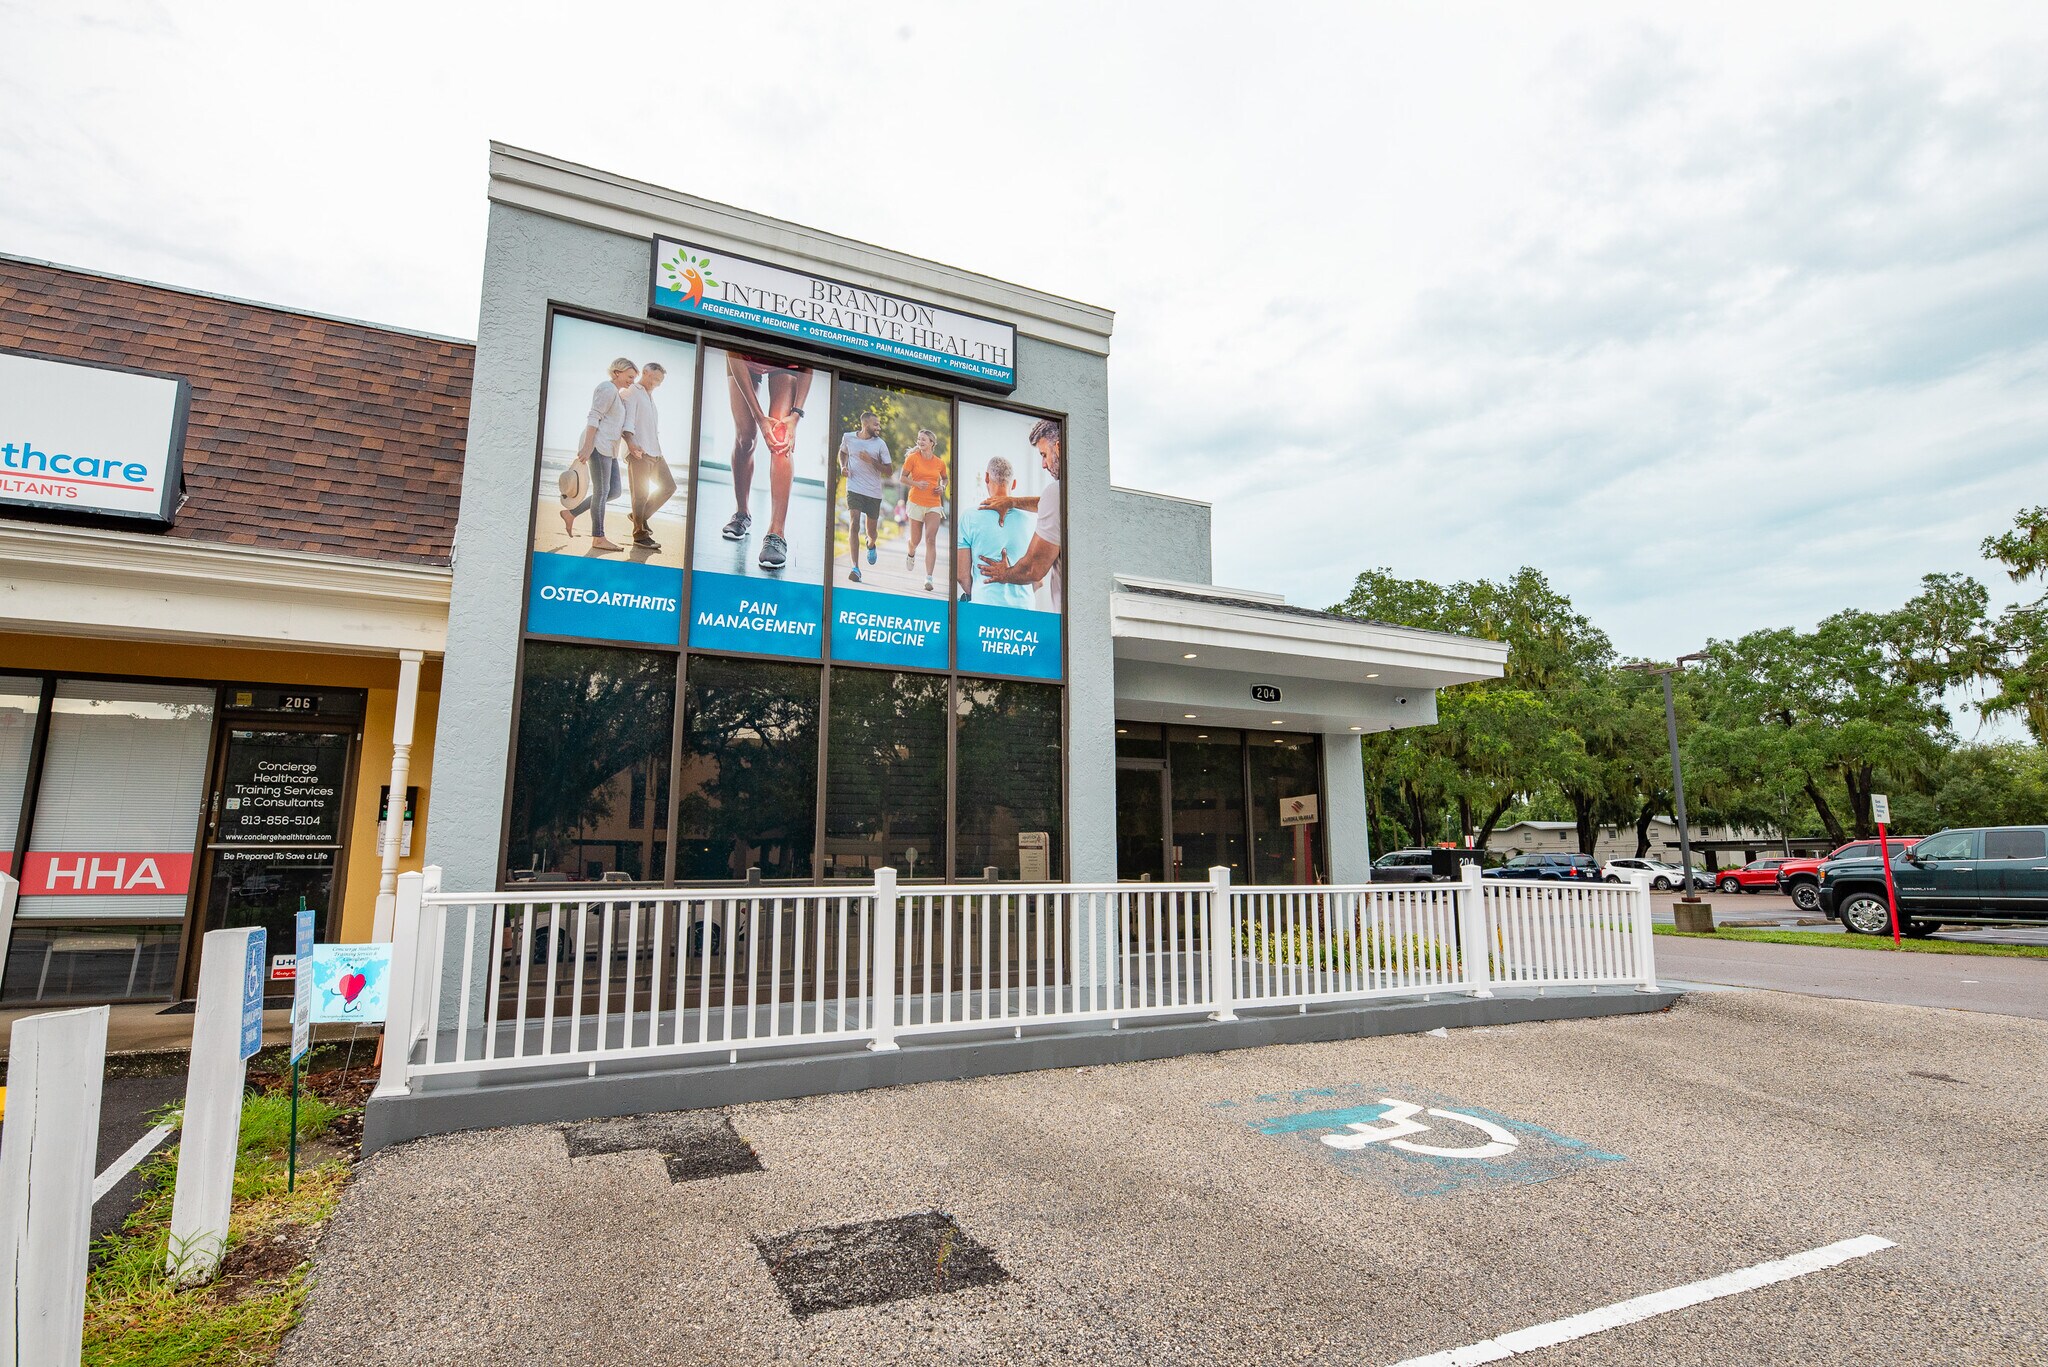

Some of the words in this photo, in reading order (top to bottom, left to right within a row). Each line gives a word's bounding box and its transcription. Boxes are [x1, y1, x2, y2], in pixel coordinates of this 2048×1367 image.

[809, 279, 935, 328] BRANDON
[721, 280, 904, 343] INTEGRATIVE
[910, 325, 1007, 367] HEALTH
[702, 302, 761, 323] REGENERATIVE
[762, 316, 800, 331] MEDICINE
[809, 327, 869, 347] OSTEOARTHRITIS
[876, 342, 892, 353] PAIN
[893, 347, 941, 364] MANAGEMENT
[950, 360, 980, 373] PHYSICAL
[981, 366, 1011, 379] THERAPY
[1, 442, 147, 483] thcare
[0, 479, 78, 498] LTANTS
[540, 585, 676, 613] OSTEOARTHRITIS
[739, 600, 778, 616] PAIN
[697, 611, 816, 636] MANAGEMENT
[839, 610, 941, 634] REGENERATIVE
[855, 627, 925, 647] MEDICINE
[978, 625, 1039, 644] PHYSICAL
[981, 640, 1036, 657] THERAPY
[1256, 687, 1275, 700] 204
[285, 697, 311, 709] 206
[258, 761, 317, 774] Concierge
[253, 773, 319, 784] Healthcare
[235, 784, 281, 798] Training
[283, 785, 334, 796] Services
[242, 797, 251, 807] &
[254, 797, 325, 808] Consultants
[240, 815, 320, 825] 813-856-5104
[225, 833, 332, 843] www.conciergehealthtrain.com
[223, 852, 235, 860] Be
[236, 852, 274, 861] Prepared
[275, 852, 285, 860] To
[285, 852, 305, 860] Save
[313, 852, 328, 860] Life
[1459, 857, 1475, 868] 204
[45, 857, 166, 890] HHA
